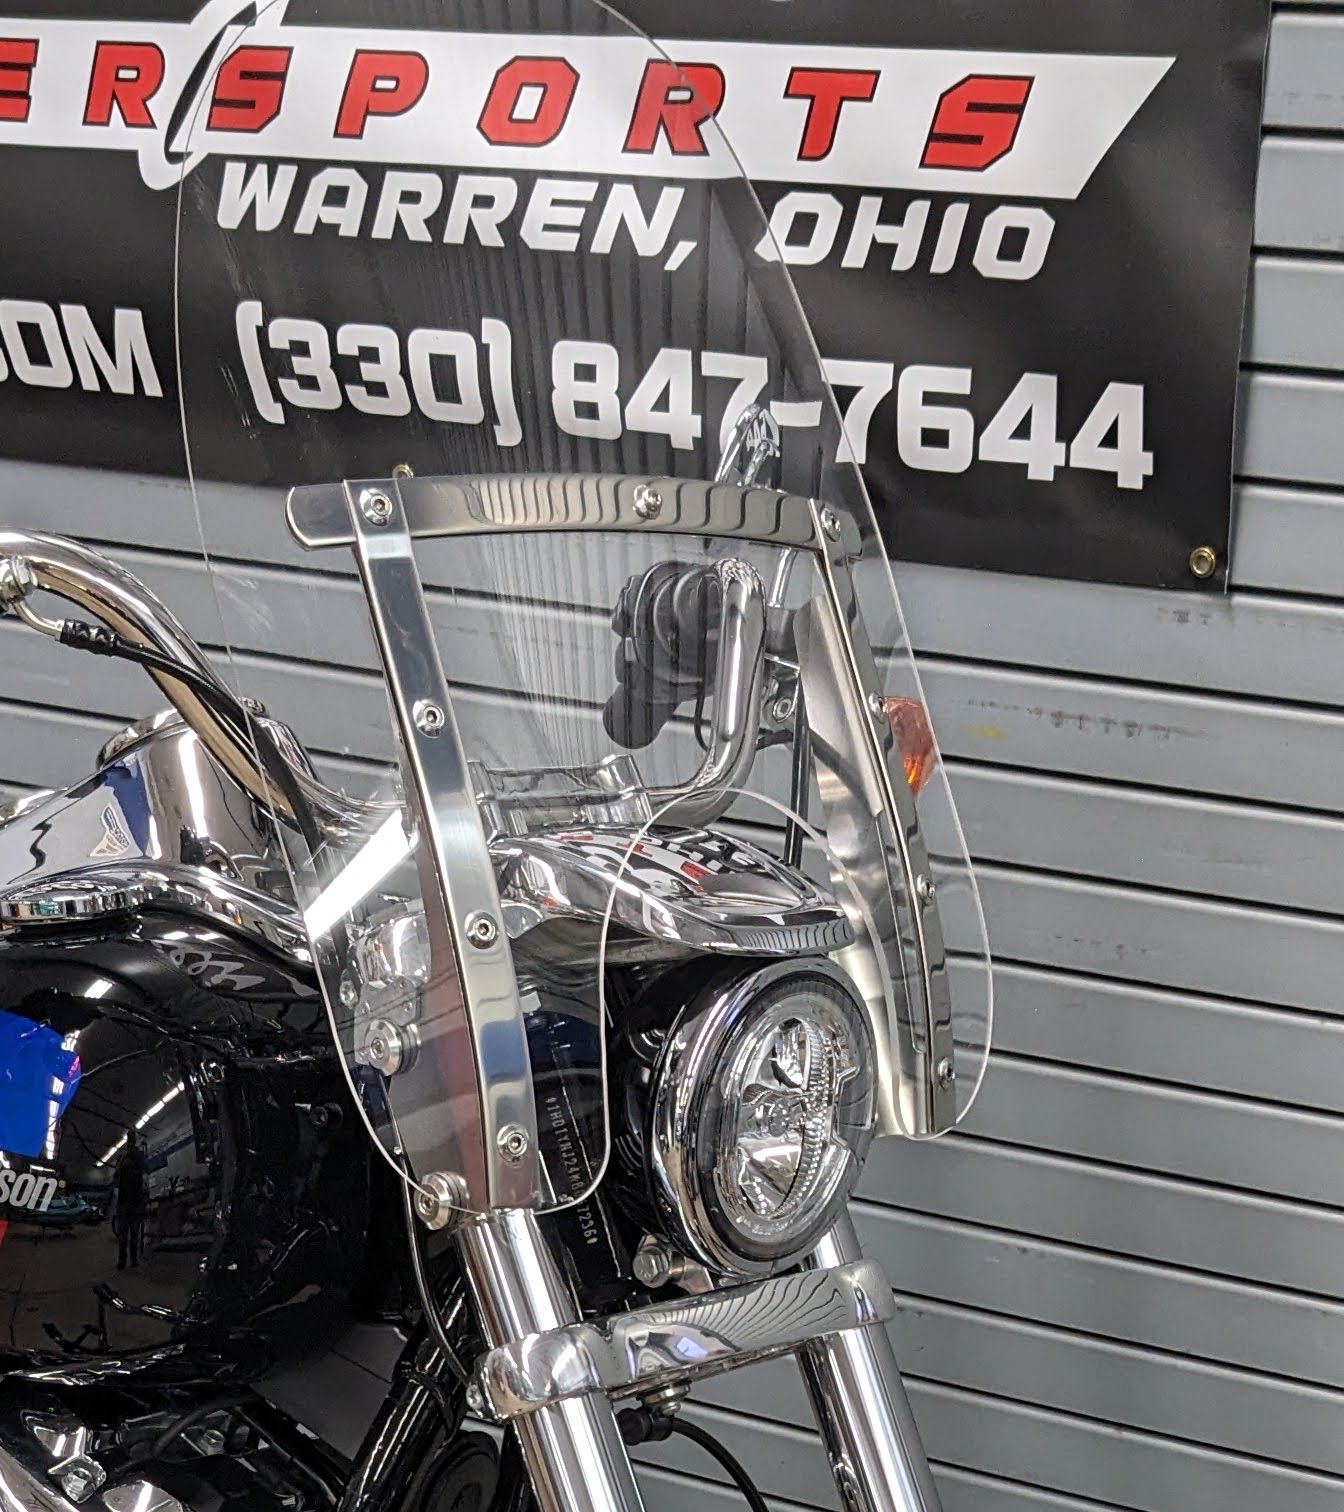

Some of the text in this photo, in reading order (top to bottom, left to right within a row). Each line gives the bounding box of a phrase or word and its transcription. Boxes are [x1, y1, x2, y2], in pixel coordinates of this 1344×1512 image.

[215, 162, 1056, 281] WARREN, OHIO
[235, 300, 1154, 491] (330) 847-7644
